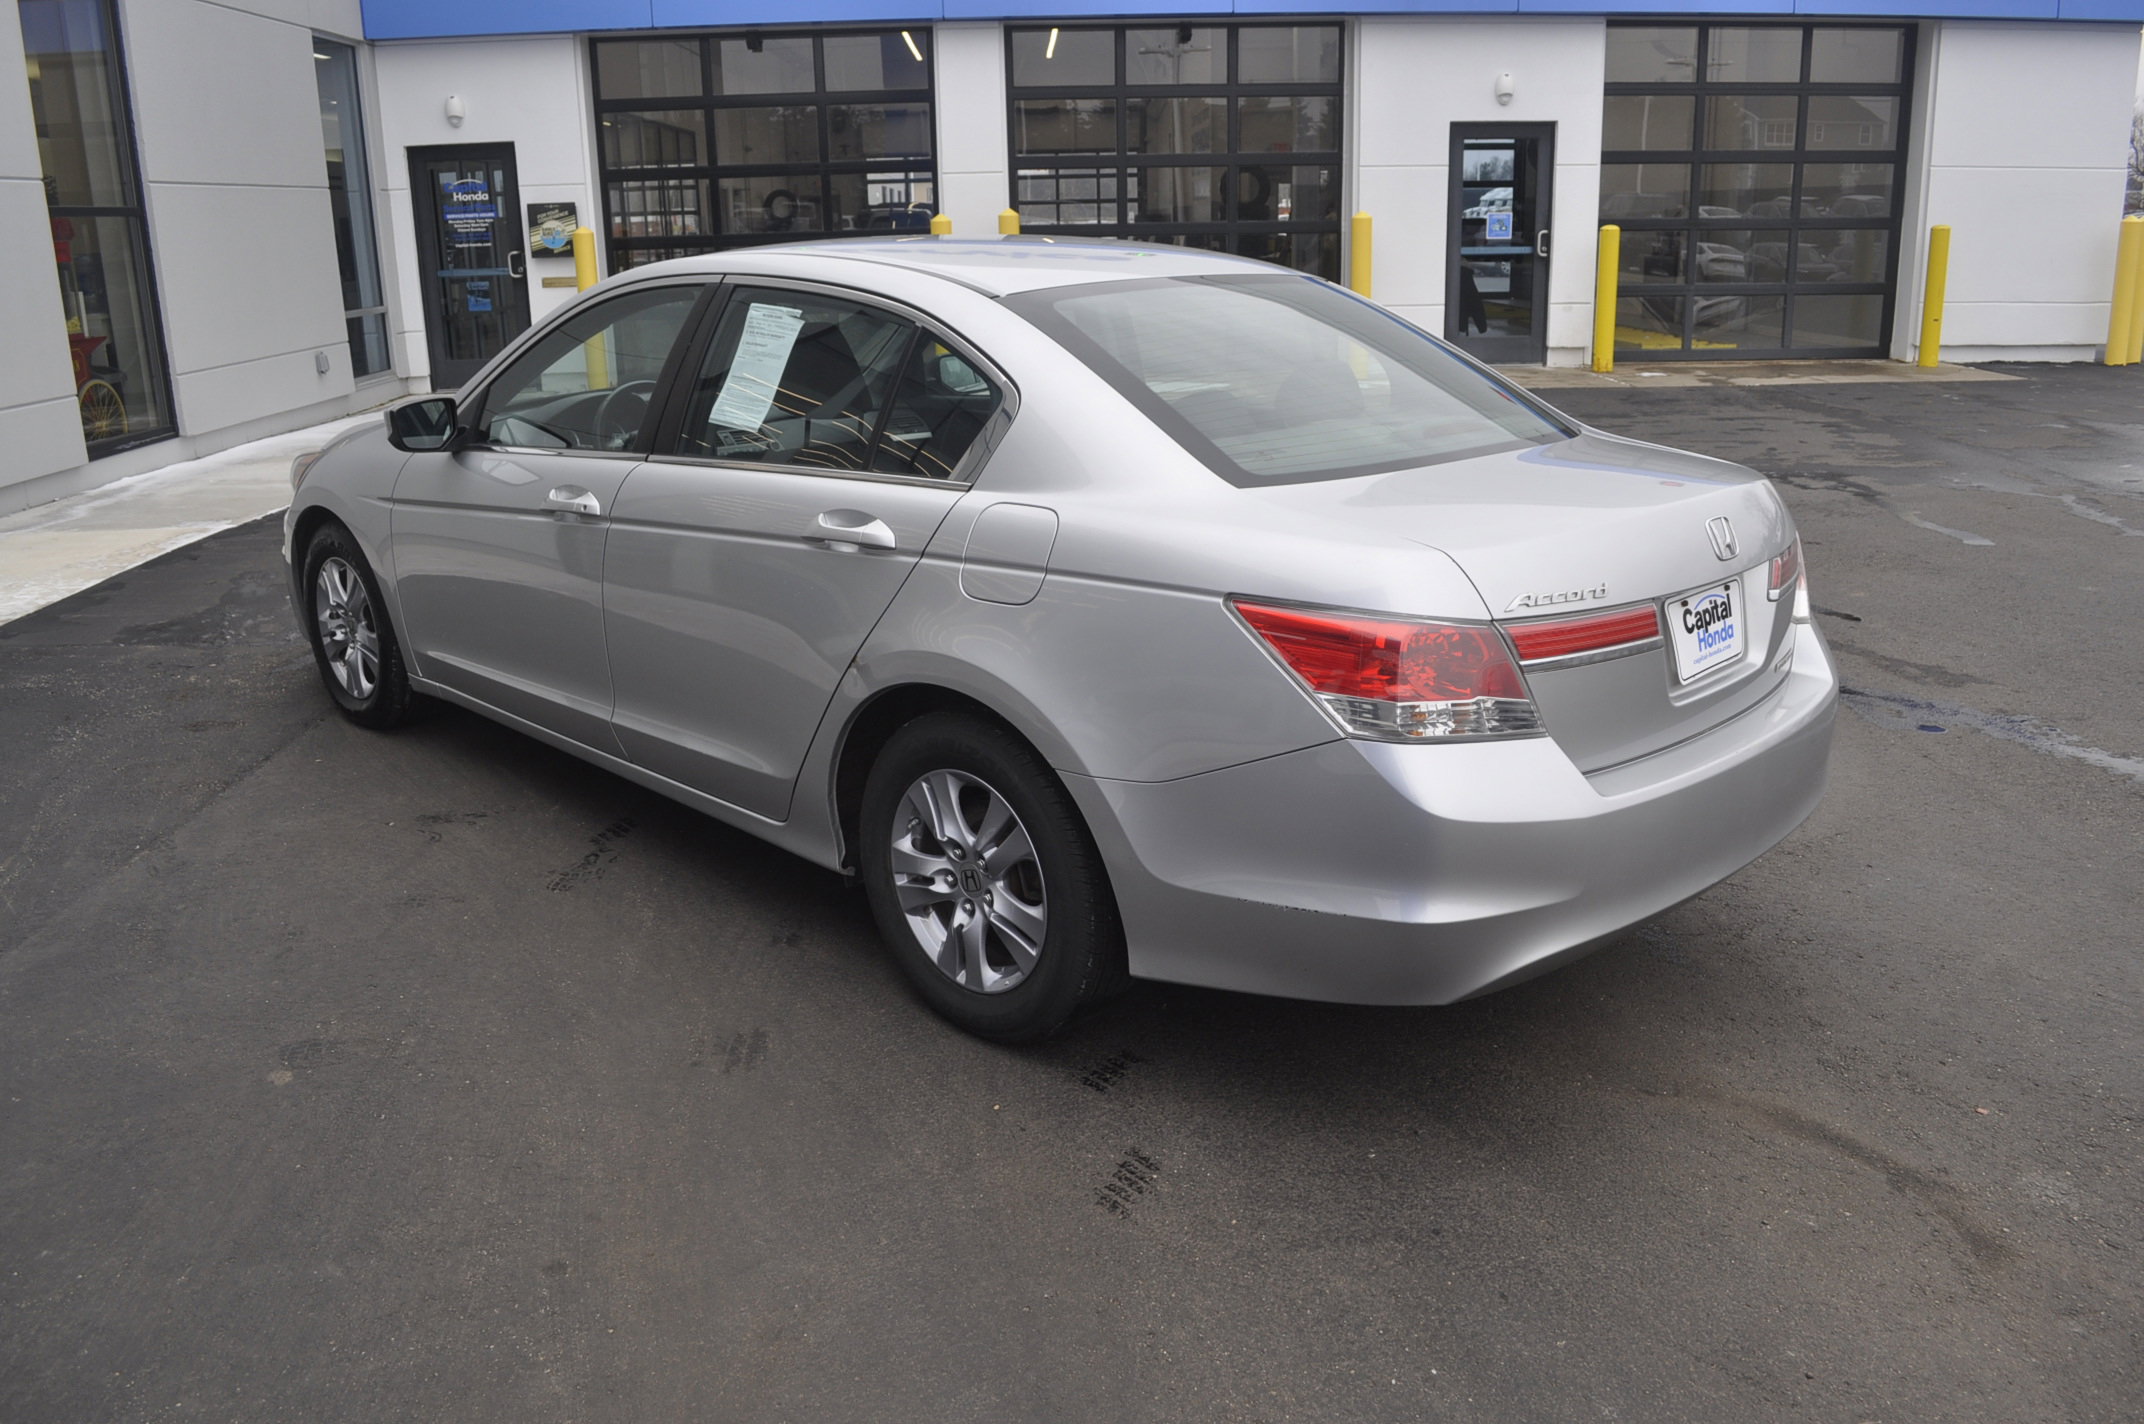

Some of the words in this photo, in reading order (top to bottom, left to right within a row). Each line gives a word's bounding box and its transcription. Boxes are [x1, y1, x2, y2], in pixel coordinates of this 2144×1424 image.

[444, 181, 487, 193] Capital
[453, 191, 489, 201] Honda
[1504, 582, 1608, 613] Accord
[1683, 593, 1733, 634] Capital
[1697, 620, 1734, 652] Honda
